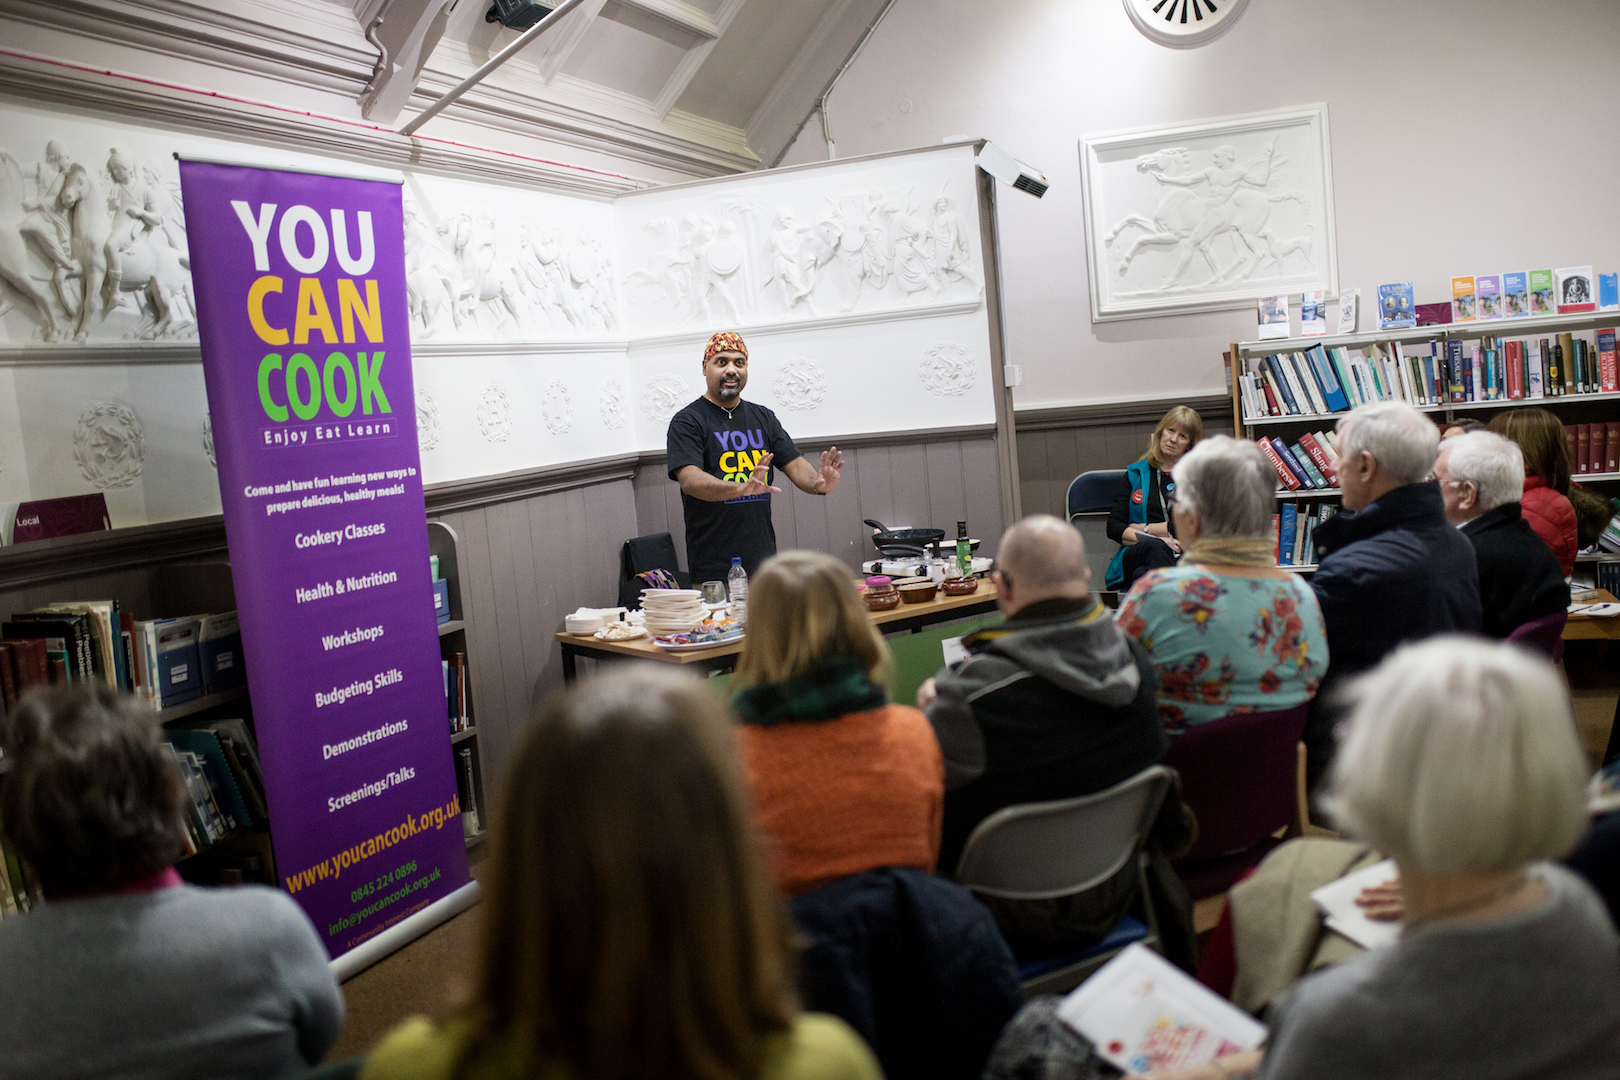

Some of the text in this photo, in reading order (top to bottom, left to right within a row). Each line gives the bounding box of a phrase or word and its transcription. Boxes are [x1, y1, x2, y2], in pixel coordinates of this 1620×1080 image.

[230, 200, 375, 276] YOU
[247, 275, 384, 346] CAN
[257, 352, 392, 422] COOK
[264, 423, 391, 446] Enjoy Eat Learn
[714, 429, 764, 451] YOU
[719, 450, 767, 474] CAN
[1260, 440, 1290, 480] Chambers
[1310, 447, 1329, 472] Slang
[244, 467, 416, 498] Come and have fun learning new ways to
[266, 484, 405, 516] prepare delicious, healthy meals!
[16, 516, 40, 527] Local
[294, 522, 386, 549] Cookery Classes
[296, 571, 398, 604] Health & Nutrition
[322, 625, 384, 651] Workshops
[314, 668, 404, 708] Budgeting Skills
[322, 719, 408, 760] Demonstrations
[327, 766, 416, 813] Screenings/Talks
[285, 793, 461, 894] www.youcancook.org.uk
[328, 866, 442, 936] info@youcancook.org.uk
[350, 860, 418, 903] 0845 224 0896
[352, 922, 384, 947] Community
[405, 898, 430, 917] Company
